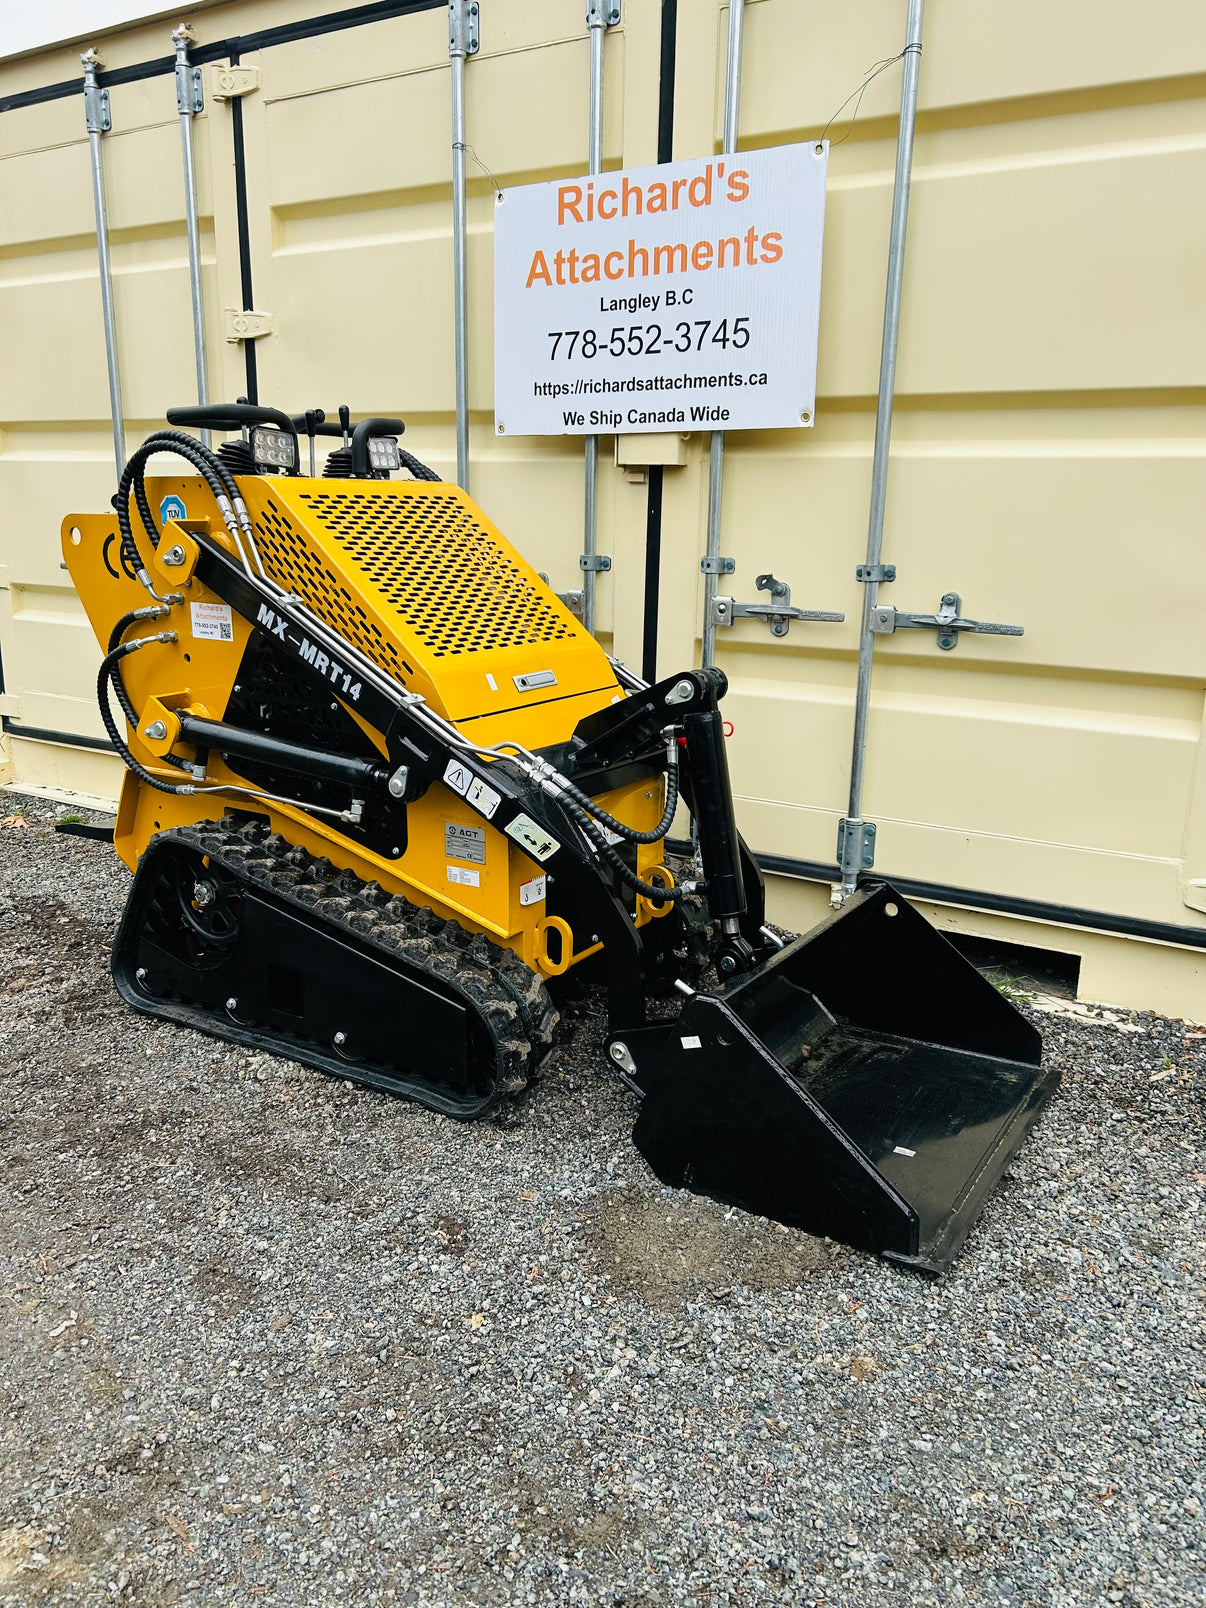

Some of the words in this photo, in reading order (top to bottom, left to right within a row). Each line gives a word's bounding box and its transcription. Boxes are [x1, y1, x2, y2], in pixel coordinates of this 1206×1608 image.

[557, 162, 750, 226] Richard's
[525, 225, 784, 289] Attachments
[600, 293, 660, 313] Langley
[665, 288, 694, 306] B.C
[548, 317, 751, 361] 778-552-3745
[533, 372, 768, 398] https://richardsattachments.ca
[562, 411, 585, 426] We
[589, 409, 623, 428] Ship
[627, 408, 685, 424] Canada
[690, 406, 730, 421] Wide
[256, 602, 362, 701] MX-MRT14
[459, 828, 479, 838] AGT
